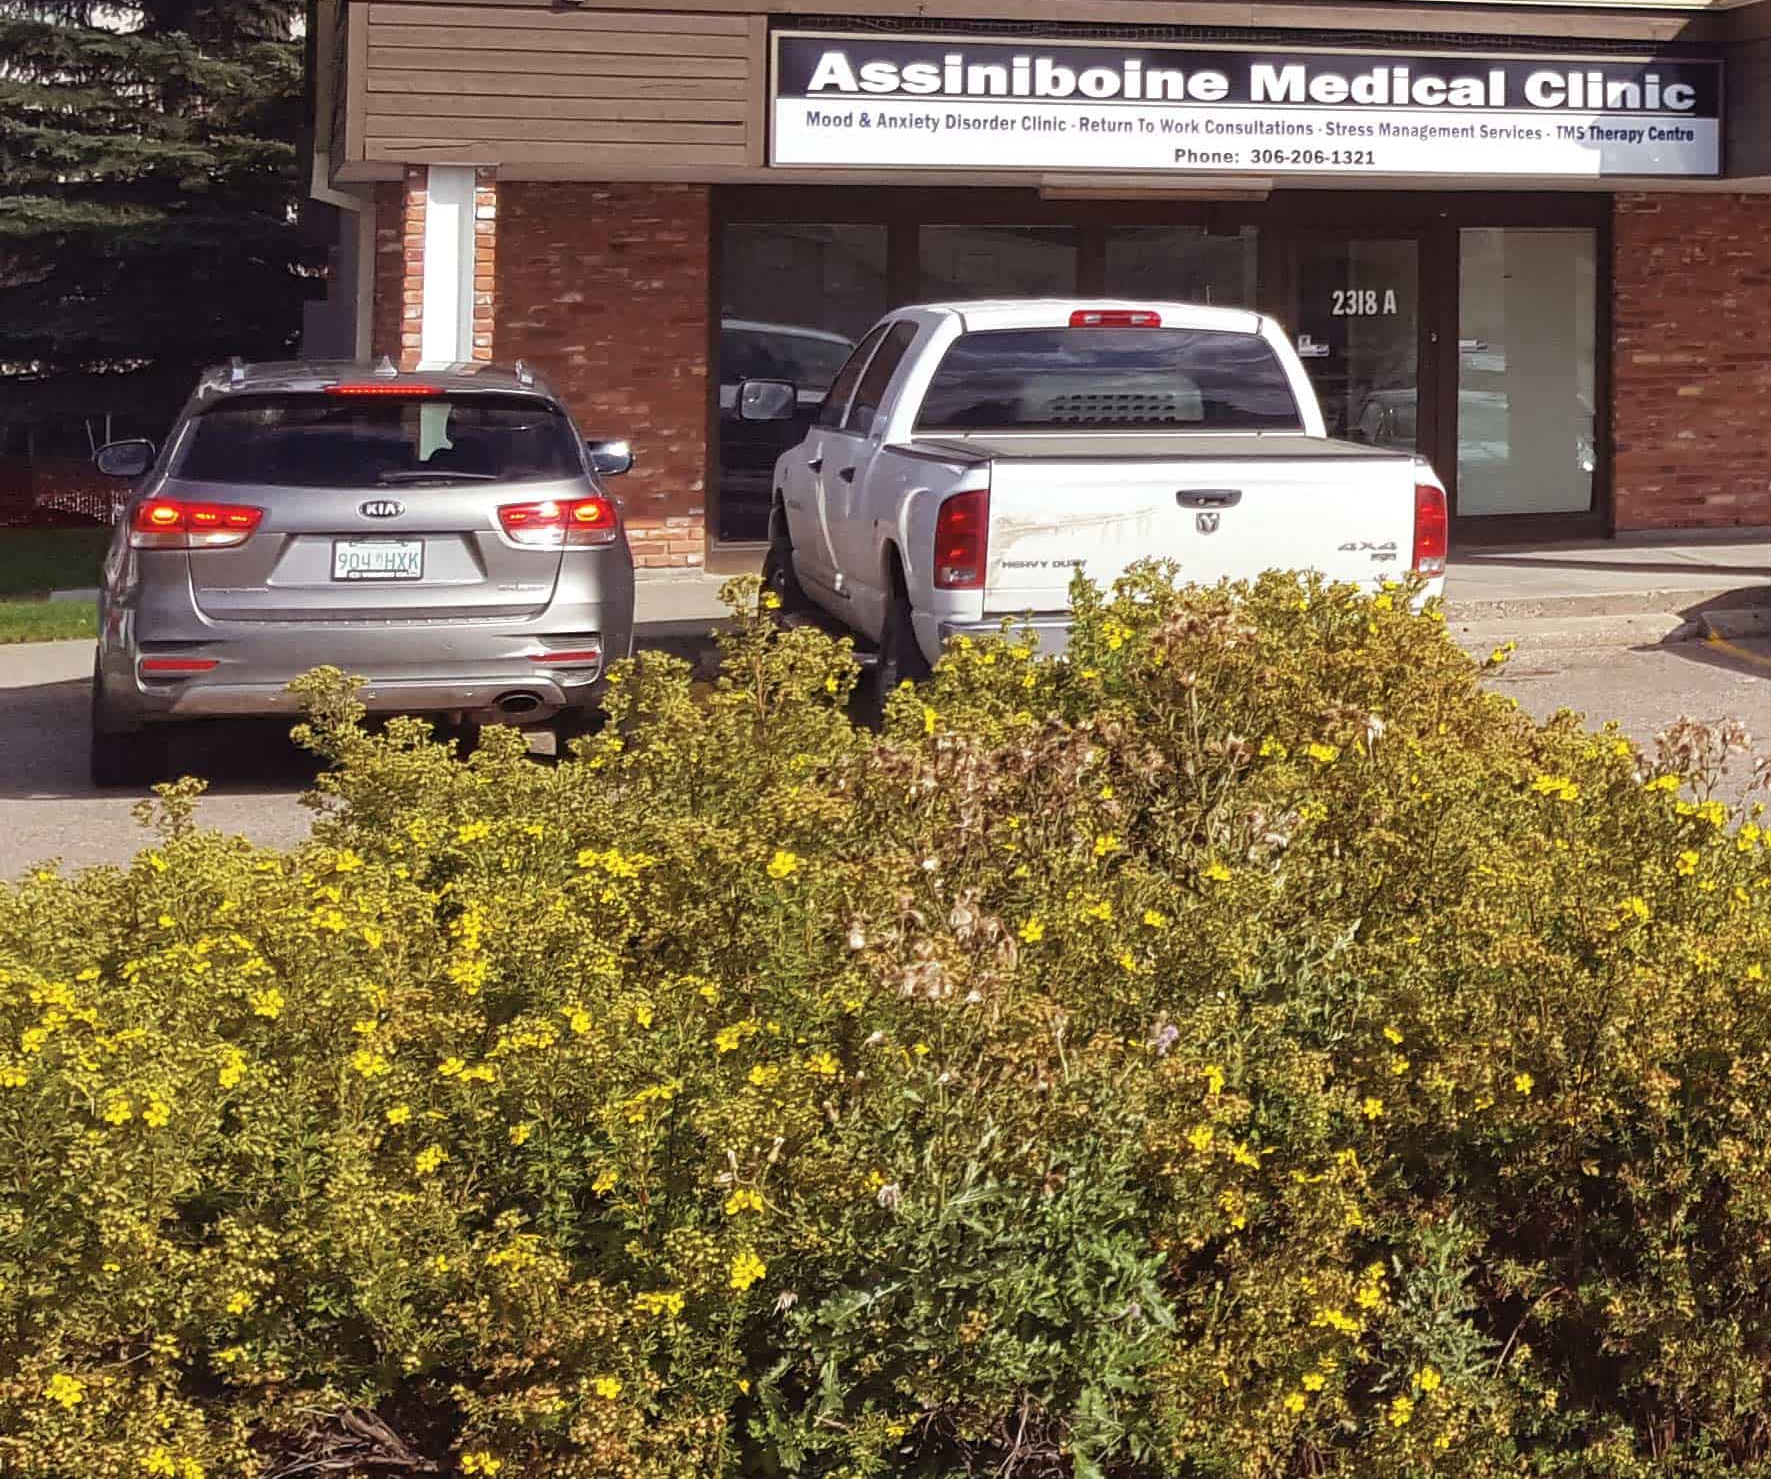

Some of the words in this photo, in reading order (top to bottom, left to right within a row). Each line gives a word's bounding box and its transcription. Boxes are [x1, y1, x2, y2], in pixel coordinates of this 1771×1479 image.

[807, 51, 1229, 101] Assiniboine
[1250, 64, 1505, 107] Medical
[1524, 71, 1696, 110] Clinic
[806, 111, 853, 128] Mood
[859, 113, 871, 128] &
[877, 112, 940, 133] Anxiety
[946, 114, 1016, 131] Disorder
[1022, 116, 1066, 132] Clinic
[1079, 117, 1133, 132] Return
[1138, 119, 1154, 133] To
[1160, 119, 1199, 134] Work
[1205, 120, 1313, 136] Consultations
[1326, 121, 1374, 136] Stress
[1379, 122, 1474, 140] Management
[1480, 124, 1542, 139] Services
[1557, 125, 1584, 139] TMS
[1589, 125, 1643, 143] Therapy
[1648, 126, 1694, 142] Centre
[1175, 149, 1239, 164] Phone:
[1250, 150, 1375, 165] 306-206-1321
[1332, 290, 1377, 315] 2318
[1383, 289, 1397, 314] A
[366, 503, 398, 515] KIA
[338, 553, 371, 570] 904
[385, 553, 418, 570] HXK
